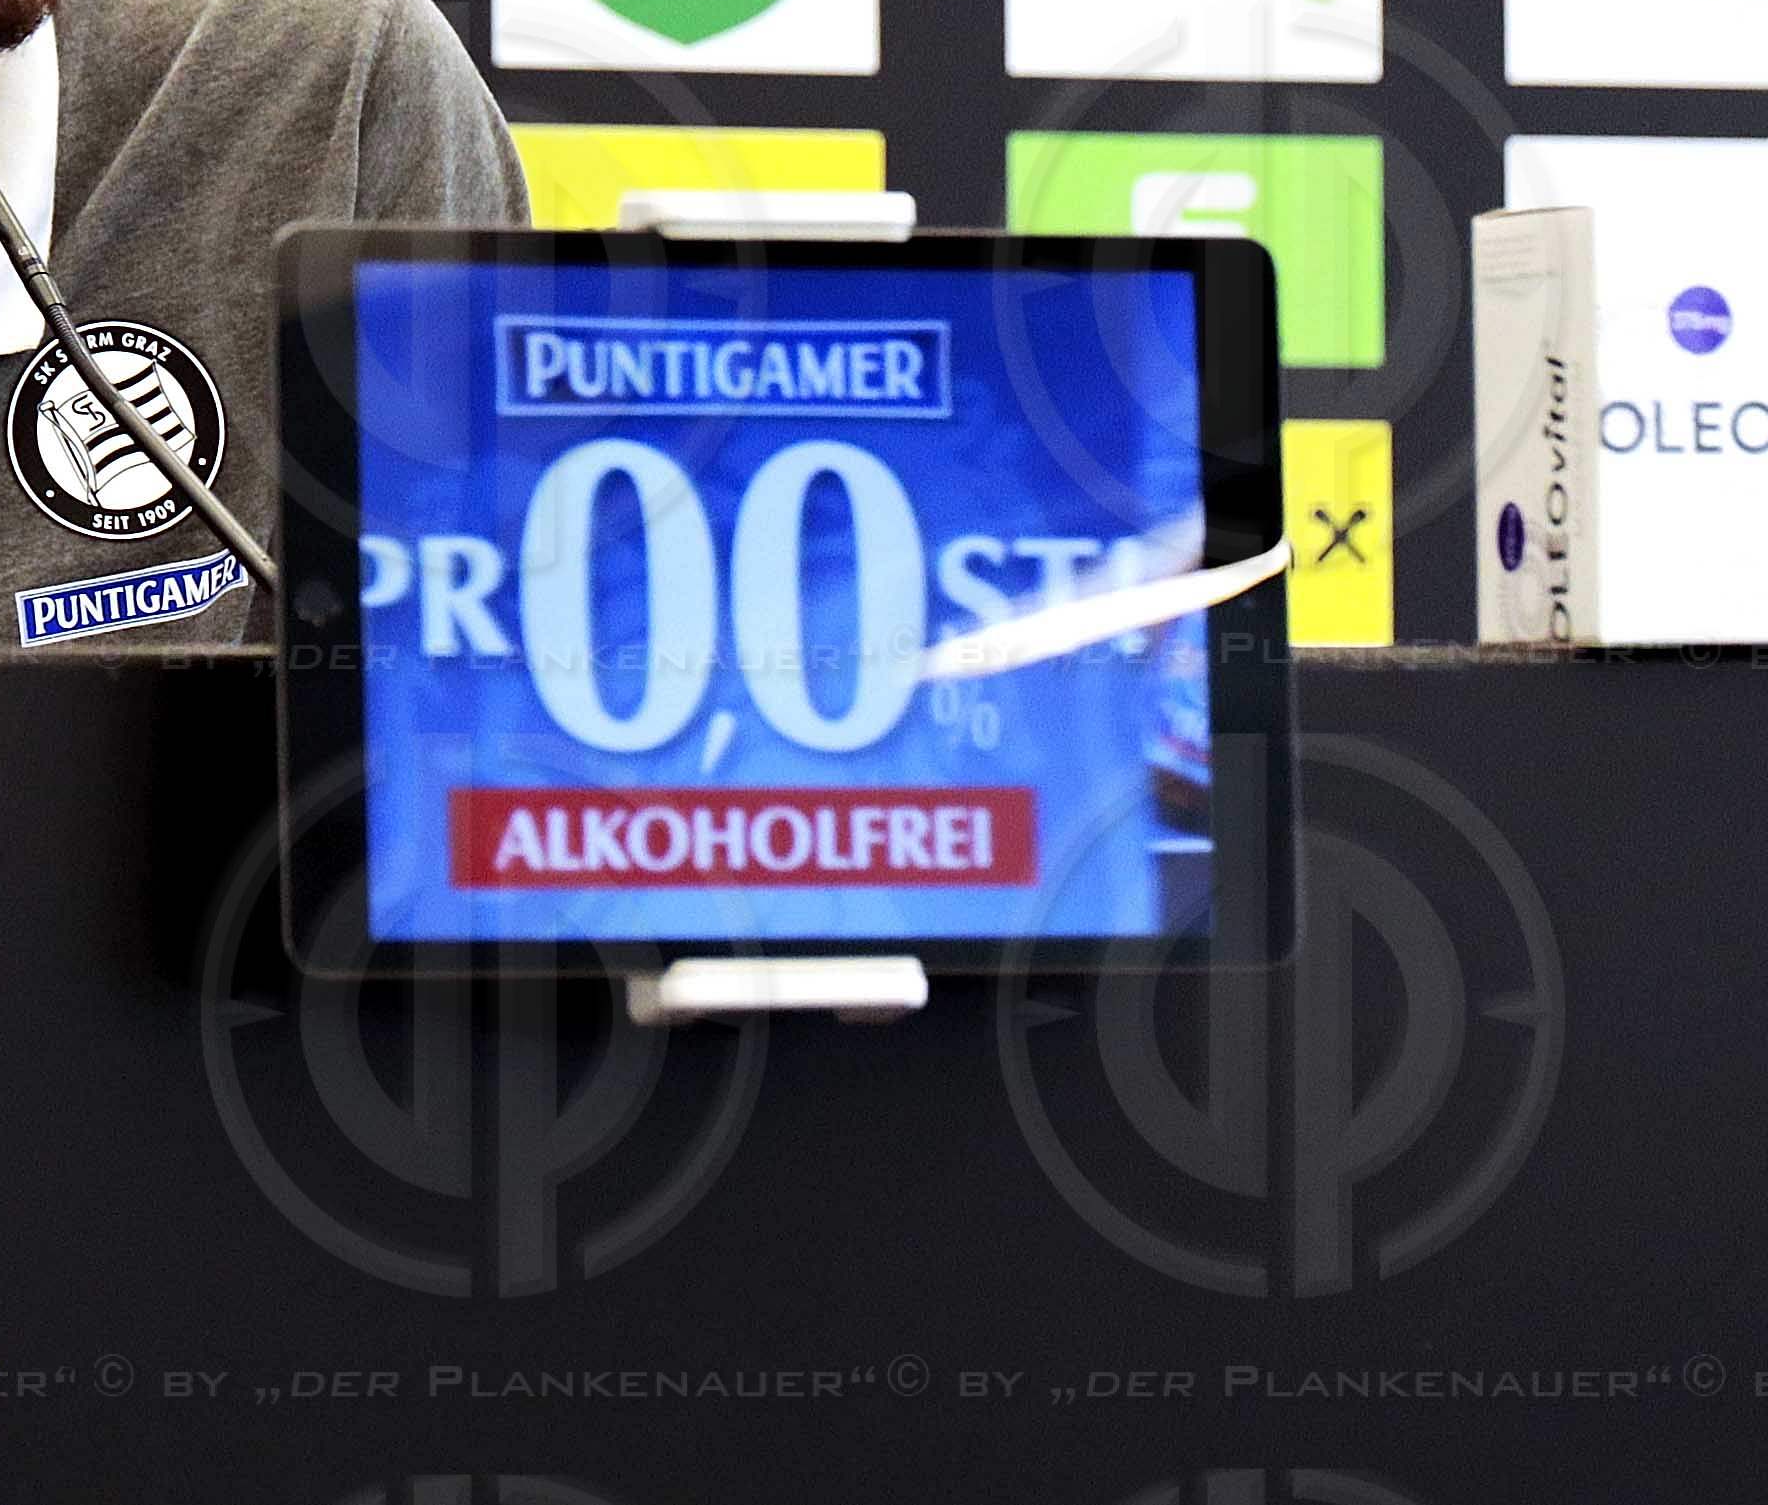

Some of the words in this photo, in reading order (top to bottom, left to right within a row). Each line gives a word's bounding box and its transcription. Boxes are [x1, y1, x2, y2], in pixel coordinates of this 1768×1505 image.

[34, 362, 56, 385] SK
[56, 334, 114, 364] SRM
[121, 333, 172, 363] GRAZ
[523, 330, 925, 402] PUNTIGAMER
[92, 511, 129, 530] SEIT
[137, 499, 176, 527] 1909
[32, 554, 237, 636] PUNTIGAMER
[494, 806, 993, 872] ALKOHOLFREI
